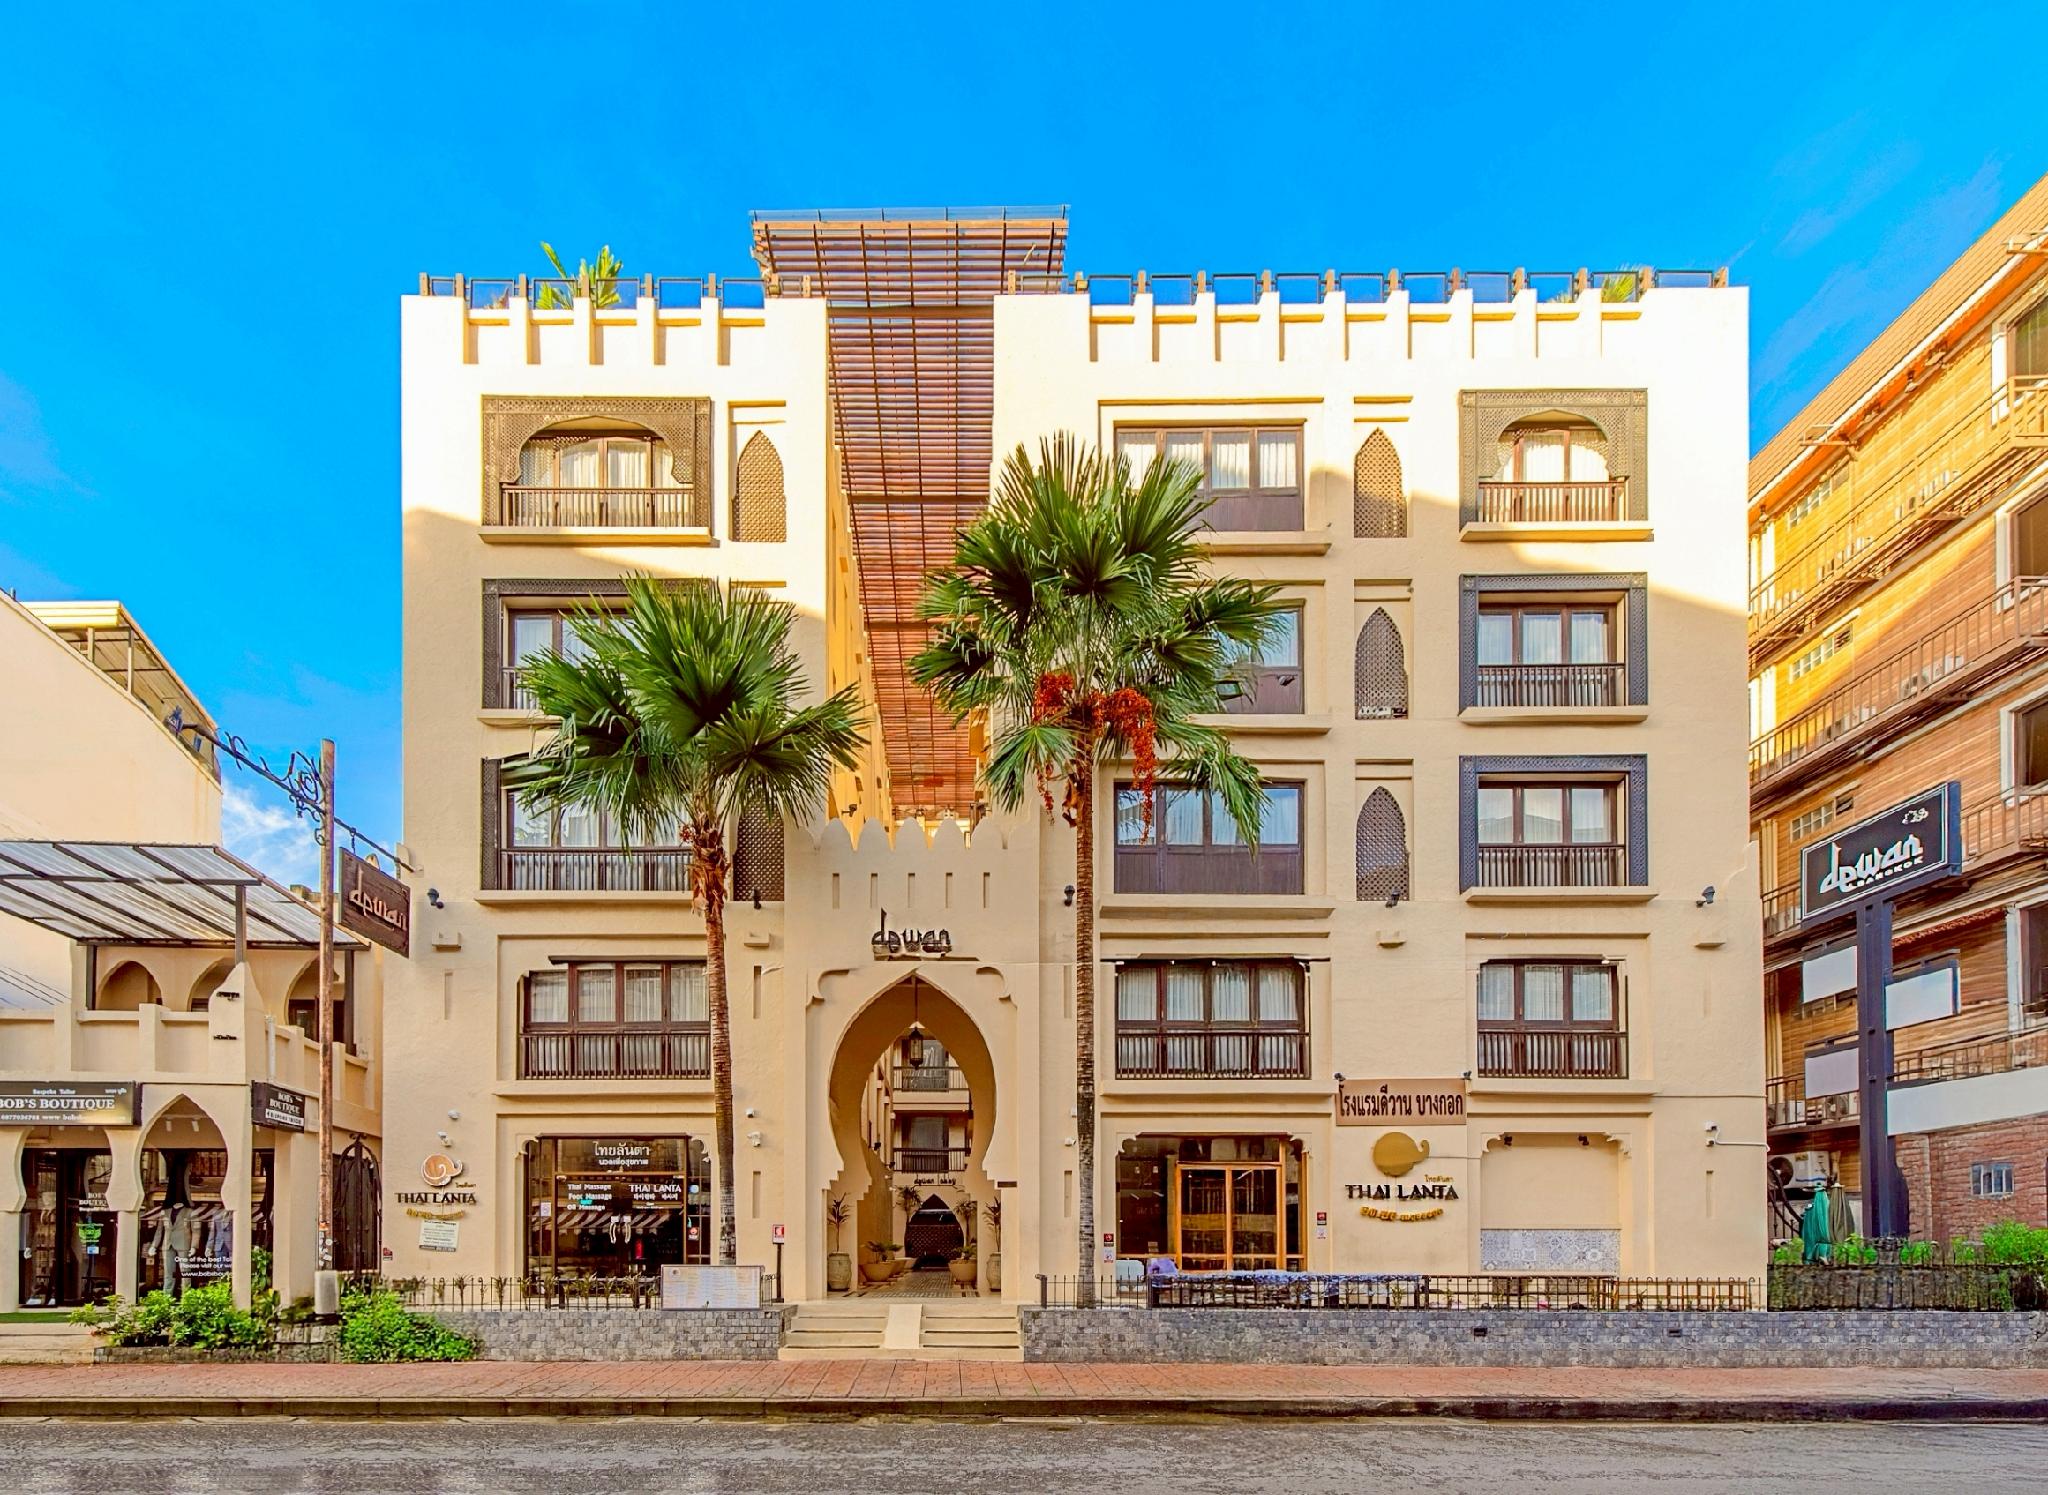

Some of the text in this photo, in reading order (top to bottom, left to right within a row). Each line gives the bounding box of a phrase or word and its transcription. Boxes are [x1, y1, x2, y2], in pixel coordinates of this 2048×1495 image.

[1820, 833, 1924, 893] dewan
[1856, 855, 1924, 888] BANGKOK
[871, 907, 952, 954] dewan
[40, 1098, 115, 1111] BOUTIQUE
[1338, 1085, 1463, 1116] โรงแรมดีวาน บางกอก
[592, 1141, 651, 1156] ไทยลันตา
[629, 1184, 682, 1193] THAI LANTA
[1345, 1184, 1459, 1201] THAI LANTA
[394, 1191, 476, 1205] THAI LANTA
